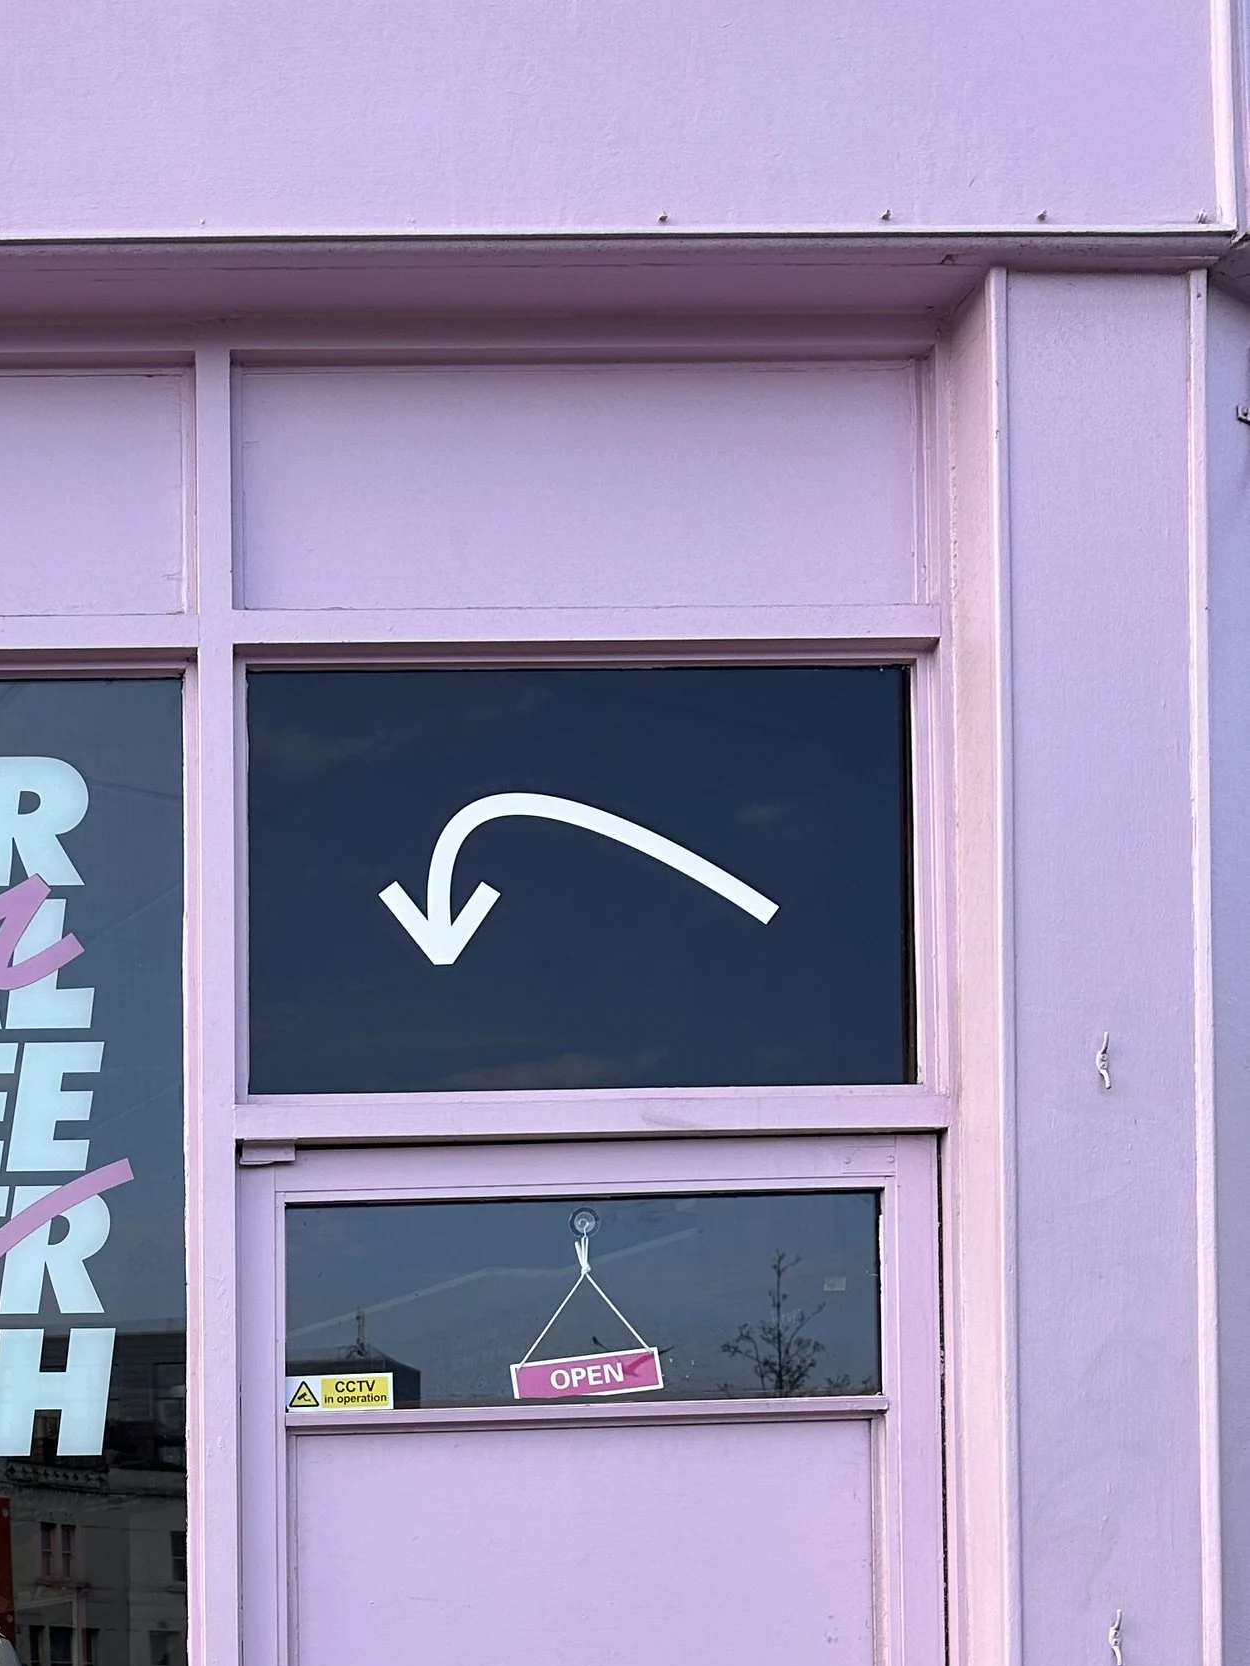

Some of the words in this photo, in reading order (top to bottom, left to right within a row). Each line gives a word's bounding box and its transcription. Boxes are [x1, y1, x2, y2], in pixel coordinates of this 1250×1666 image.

[549, 1362, 625, 1390] OPEN
[334, 1379, 376, 1394] CCTV
[324, 1393, 335, 1404] in
[337, 1392, 388, 1406] operation
